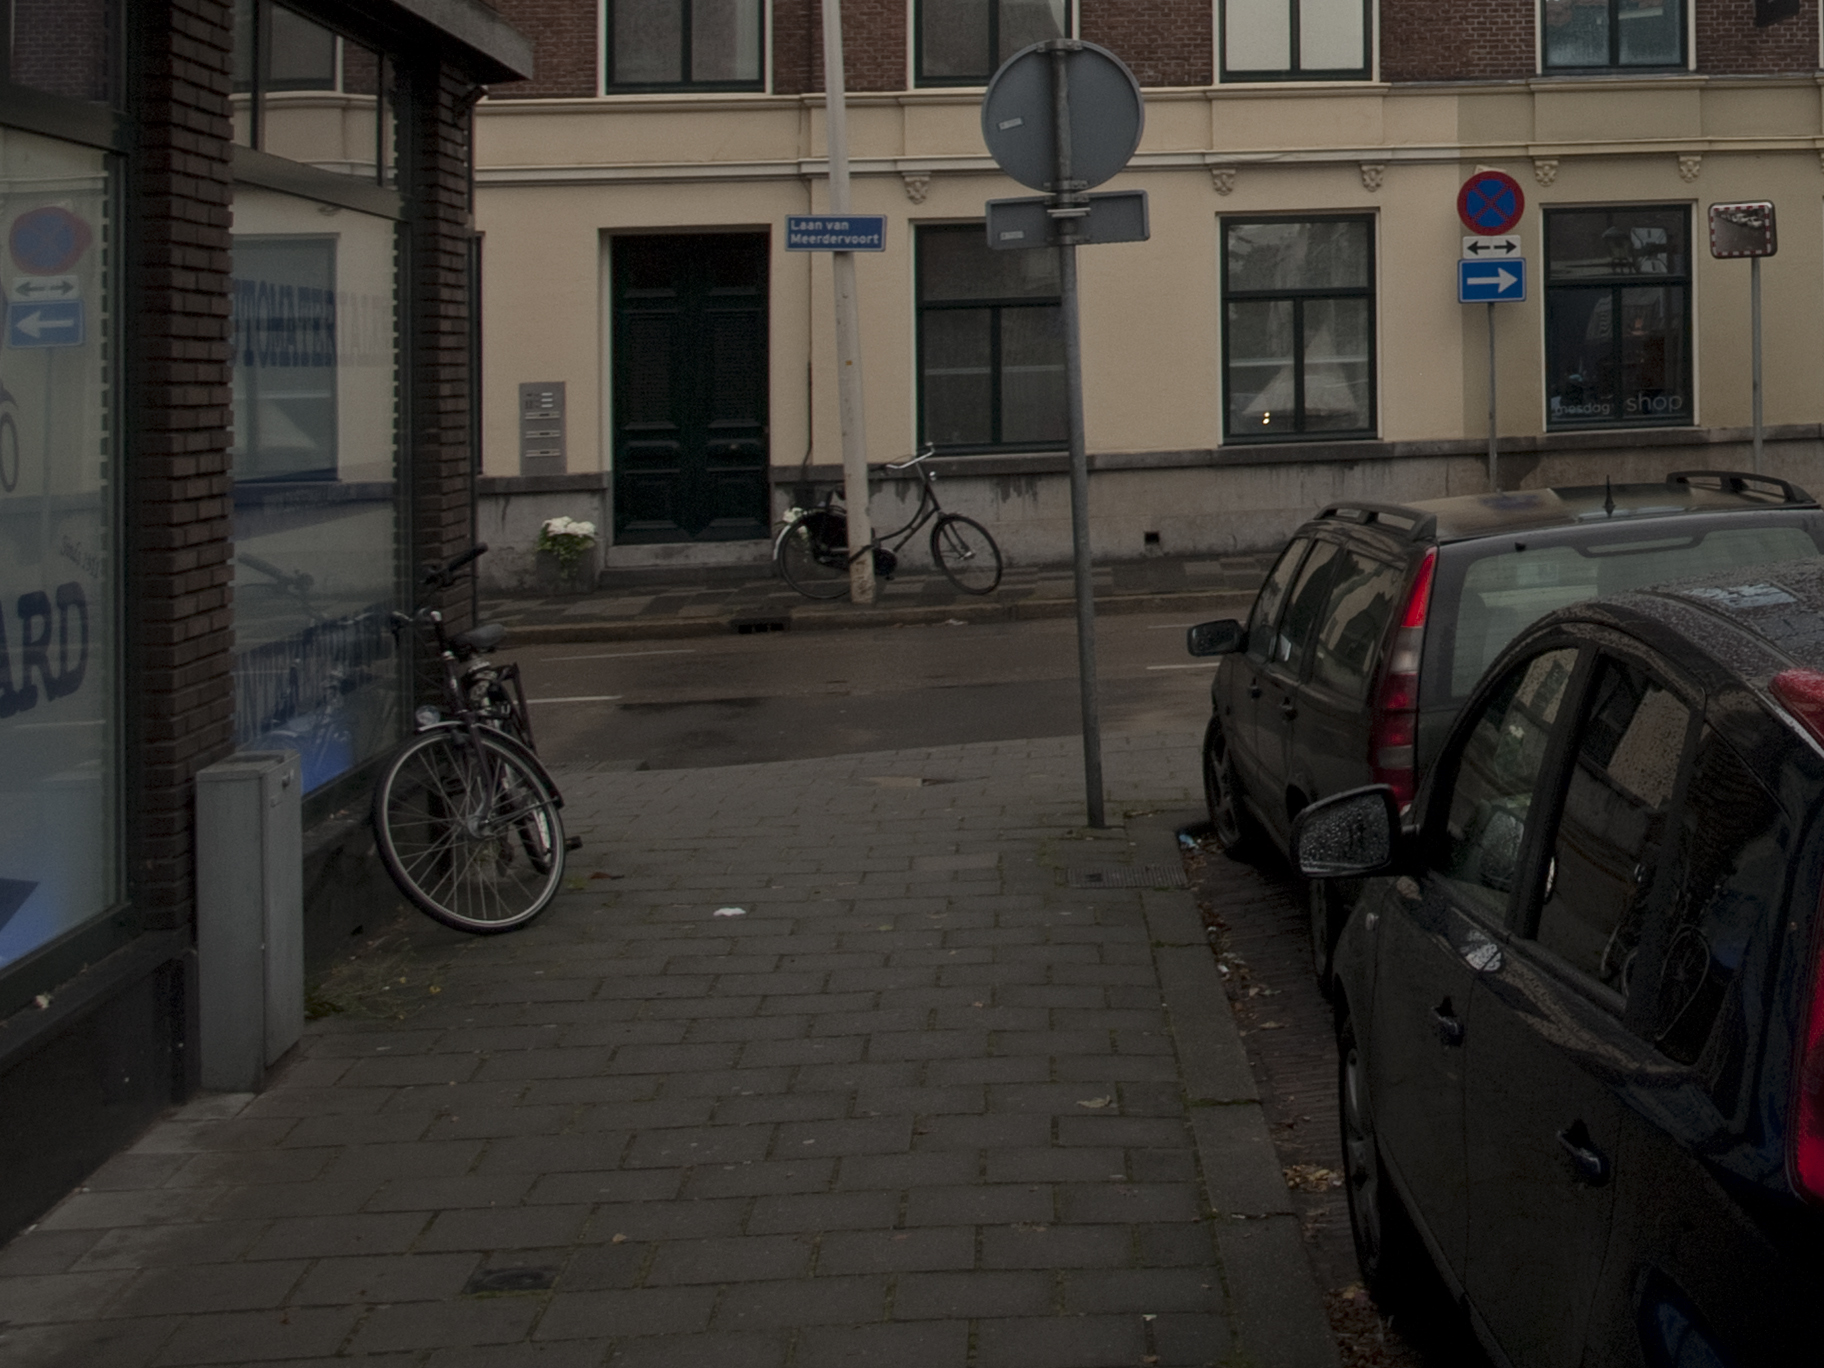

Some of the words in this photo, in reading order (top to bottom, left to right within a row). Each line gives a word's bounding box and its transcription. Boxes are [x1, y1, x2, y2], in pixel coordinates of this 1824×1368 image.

[790, 220, 823, 231] Laan
[825, 221, 849, 231] van
[790, 233, 880, 245] Meerdervoort
[1554, 402, 1611, 416] mesdag
[1626, 393, 1683, 412] shop
